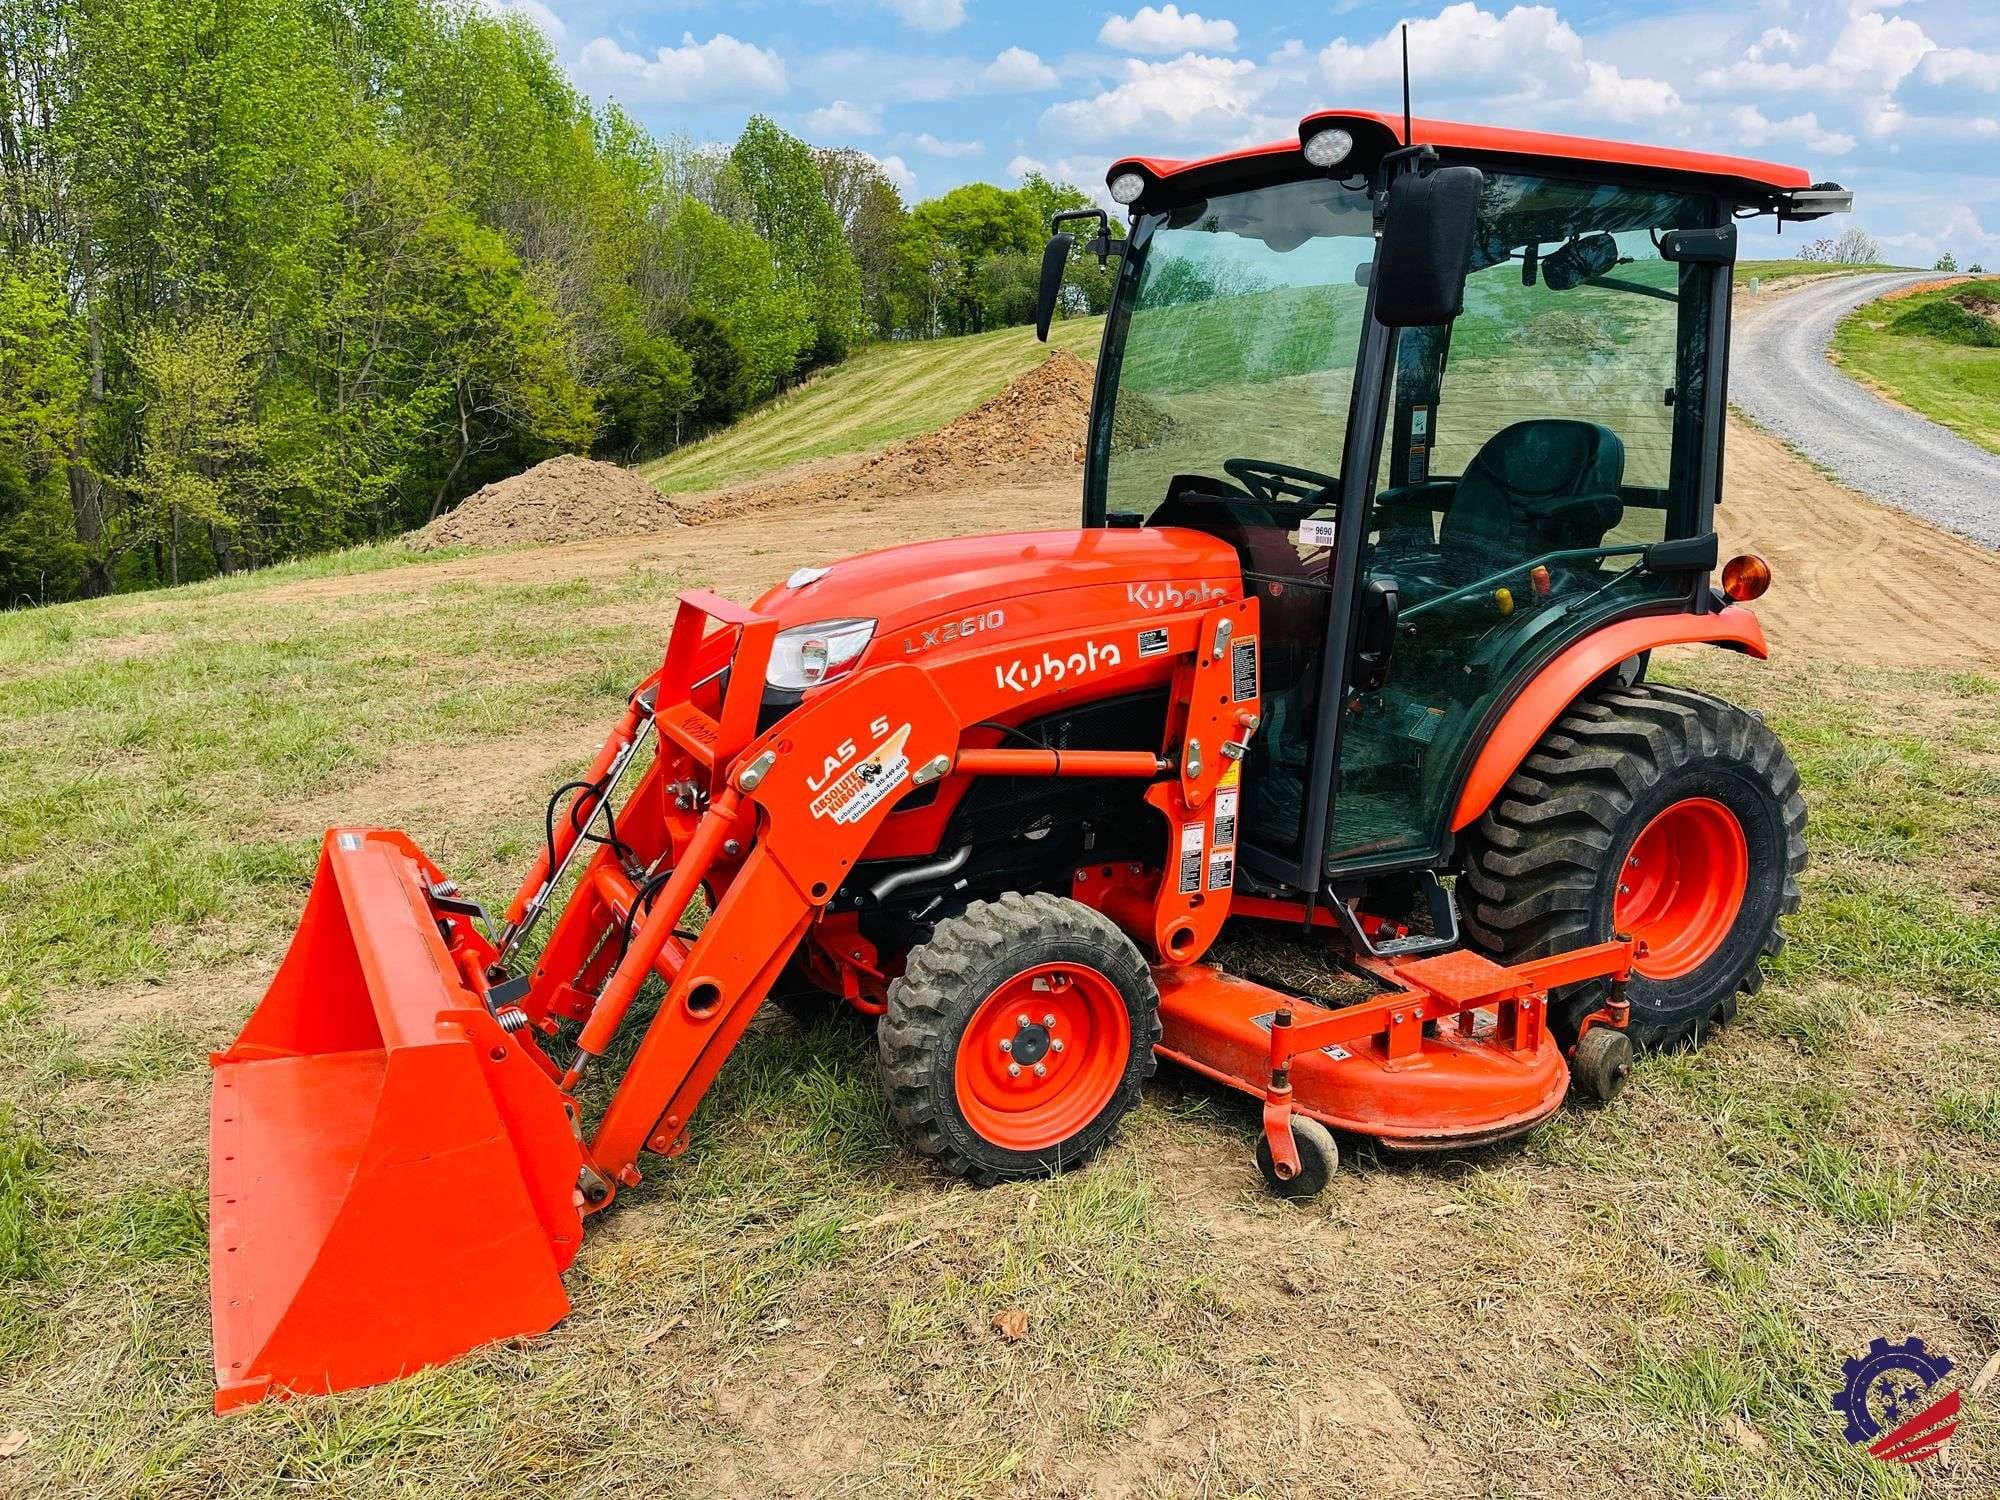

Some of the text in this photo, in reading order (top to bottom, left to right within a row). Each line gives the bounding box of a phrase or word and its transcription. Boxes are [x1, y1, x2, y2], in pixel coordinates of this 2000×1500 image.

[1315, 526, 1333, 536] 9690
[1127, 581, 1226, 609] Kubota
[904, 609, 1005, 655] LX2610
[995, 640, 1121, 692] Kubota
[813, 770, 859, 815] ABSOLUTE
[828, 776, 869, 814] KUBOTA
[851, 771, 907, 821] absolutekubota.com
[860, 791, 870, 801] TN
